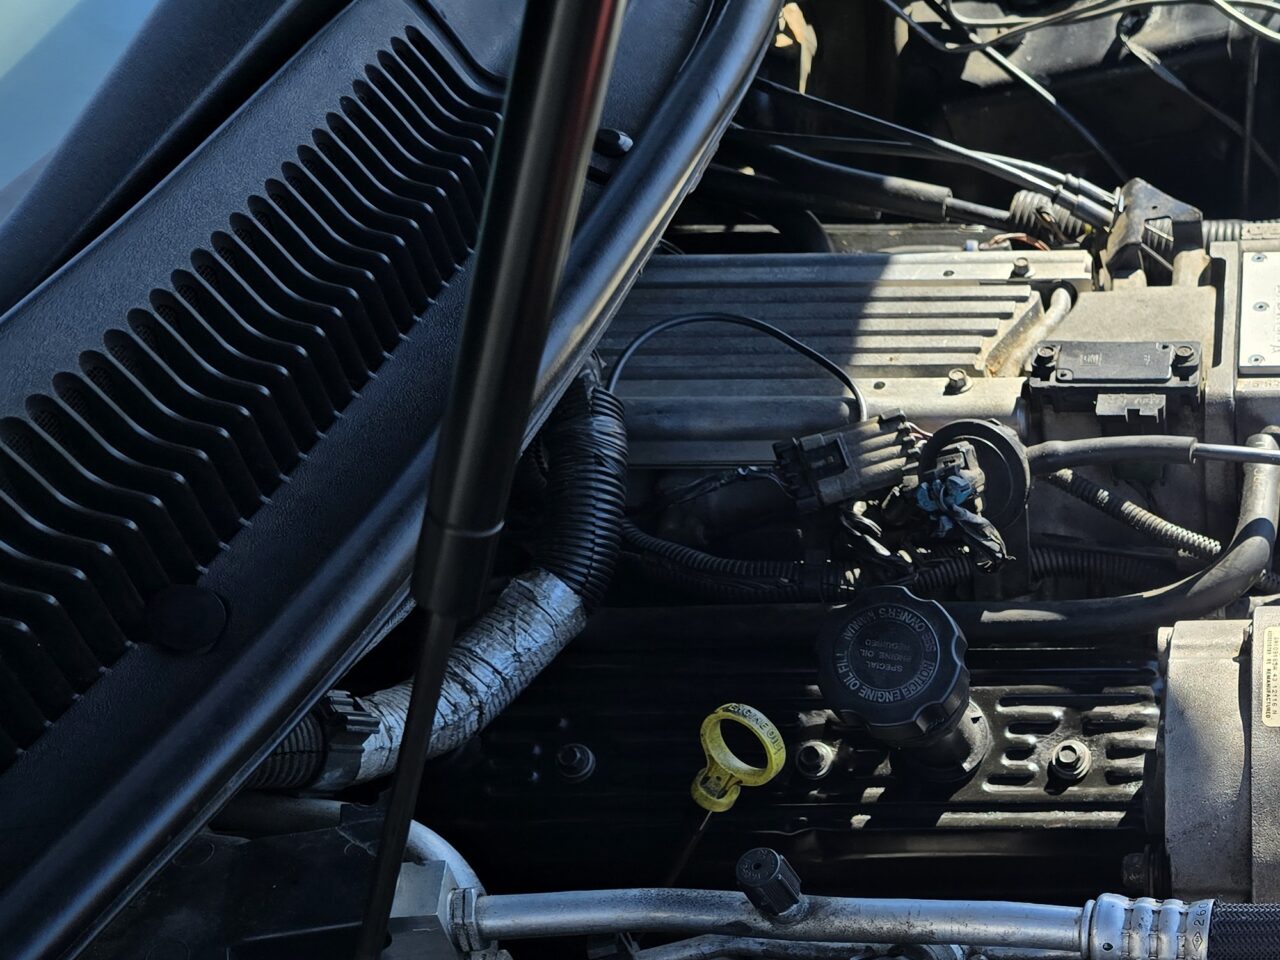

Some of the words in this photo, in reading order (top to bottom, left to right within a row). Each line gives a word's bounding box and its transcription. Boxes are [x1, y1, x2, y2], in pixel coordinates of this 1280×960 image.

[859, 648, 875, 658] OIL
[866, 661, 904, 673] SPECIAL
[842, 671, 860, 689] OIL
[858, 685, 902, 702] ENGINE
